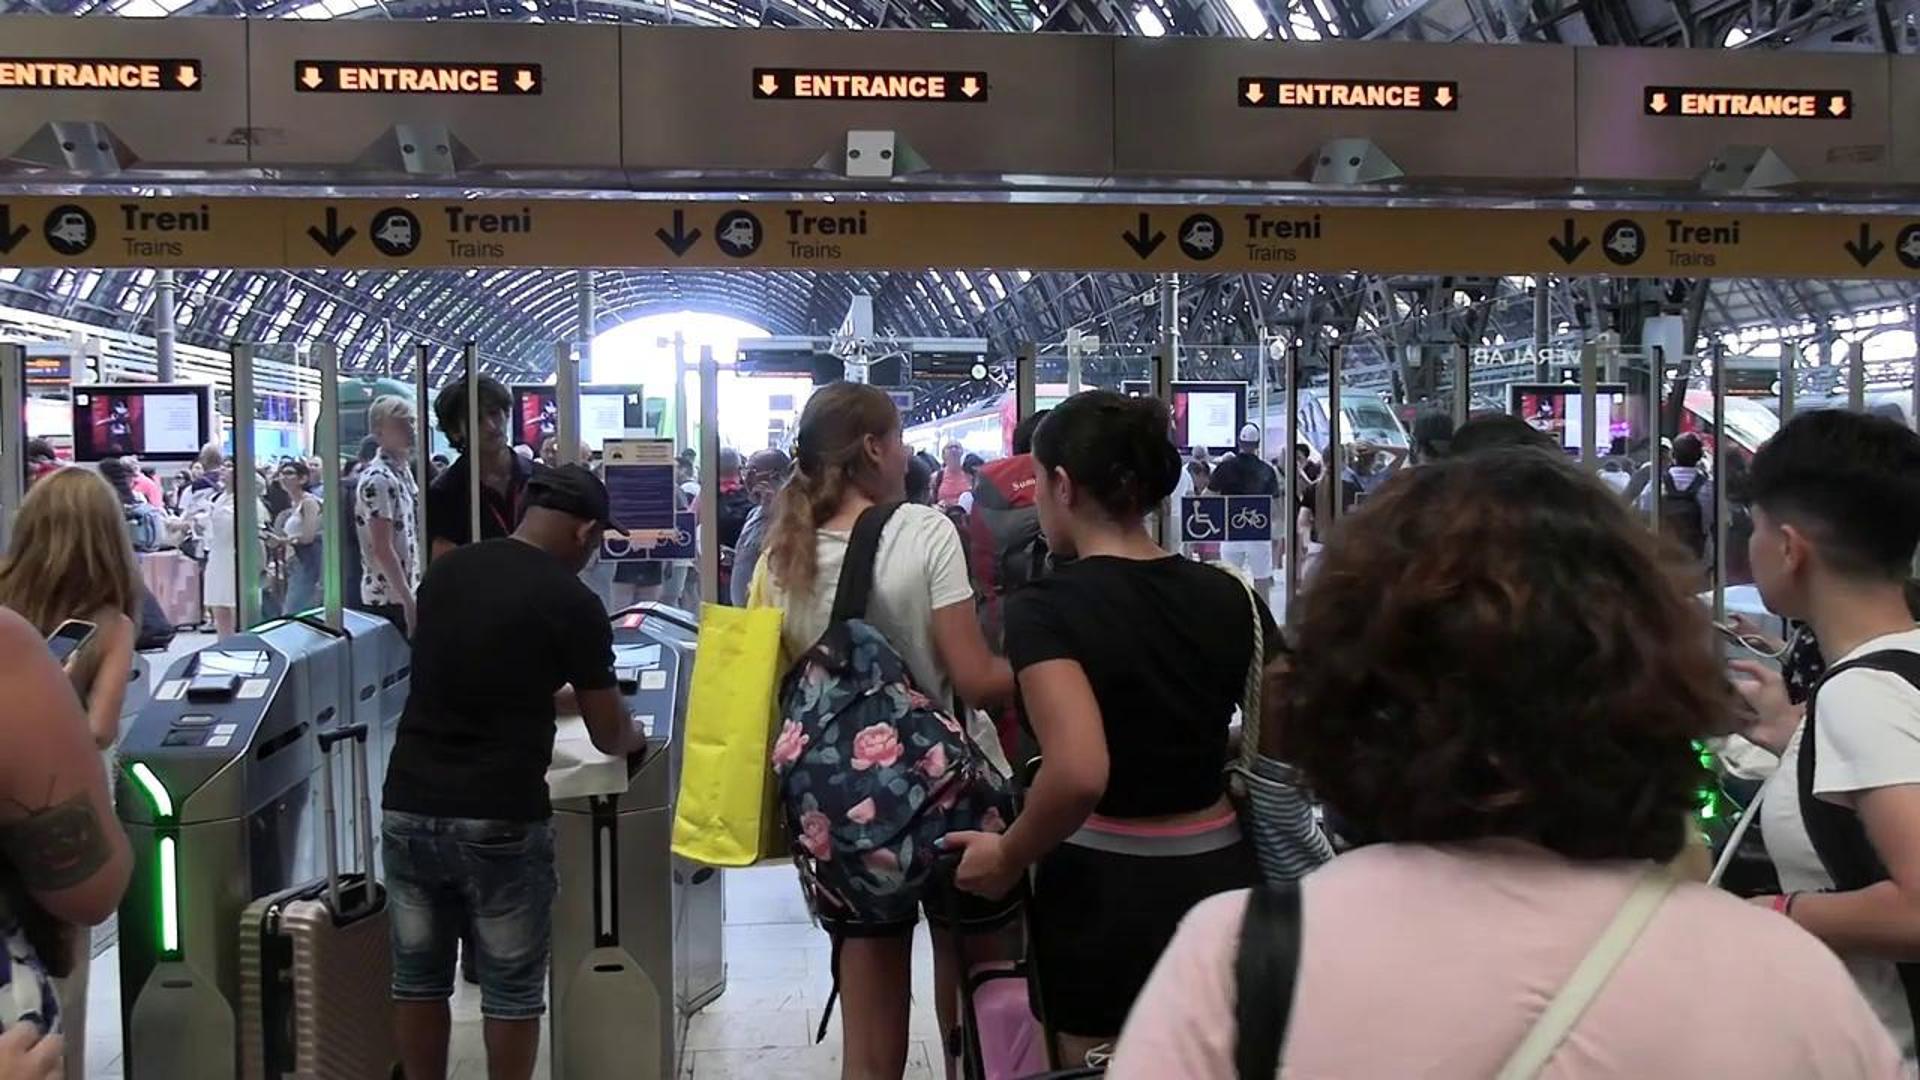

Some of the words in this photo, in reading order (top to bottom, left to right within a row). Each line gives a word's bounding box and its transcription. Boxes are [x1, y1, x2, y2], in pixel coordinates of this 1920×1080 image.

[0, 63, 160, 88] ENTRANCE
[339, 68, 498, 91] ENTRANCE
[794, 76, 945, 98] ENTRANCE
[1279, 84, 1421, 107] ENTRANCE
[1682, 93, 1816, 117] ENTRANCE
[120, 204, 210, 231] Treni
[445, 206, 530, 233] Treni
[785, 210, 867, 235] Treni
[1245, 214, 1321, 238] Treni
[1666, 219, 1740, 245] Treni
[121, 237, 182, 257] Trains
[446, 239, 504, 258] Trains
[787, 241, 841, 259] Trains
[1246, 244, 1296, 262] Trains
[1666, 248, 1716, 267] Trains
